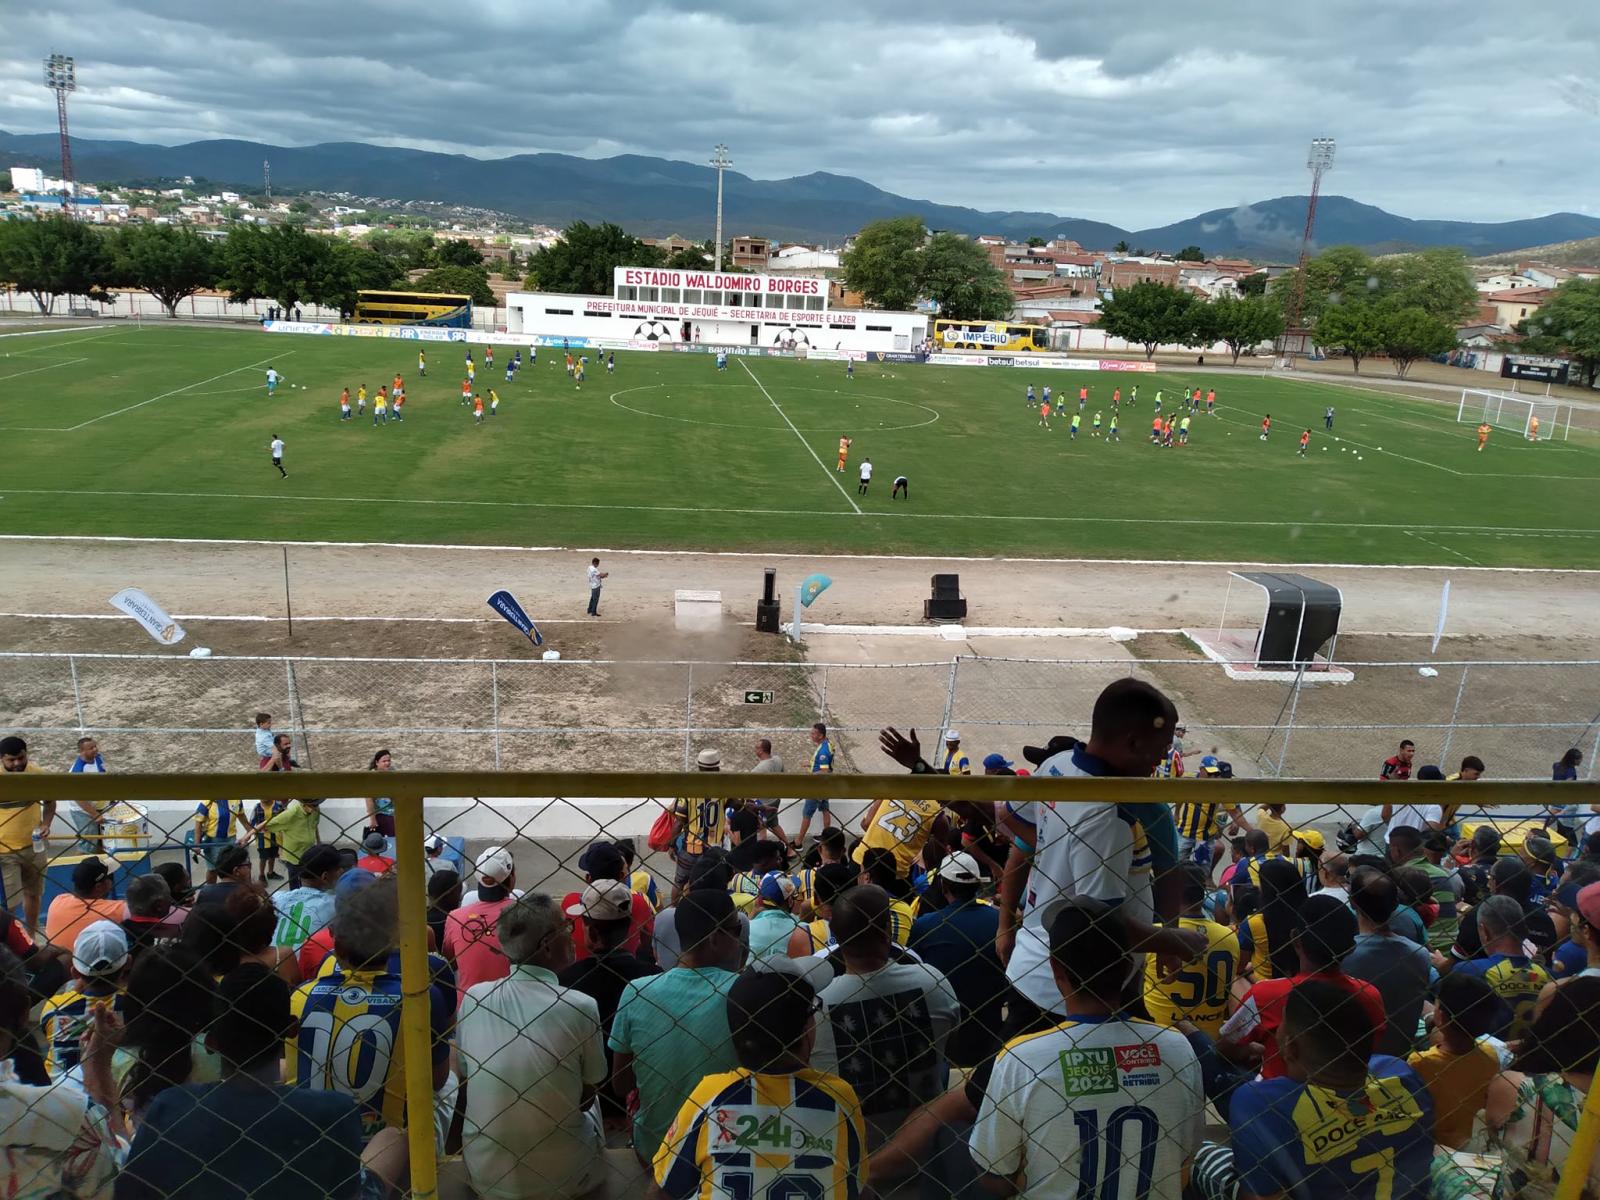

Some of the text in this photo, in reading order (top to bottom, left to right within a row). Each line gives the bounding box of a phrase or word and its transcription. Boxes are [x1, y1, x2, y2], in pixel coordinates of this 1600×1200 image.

[625, 269, 819, 294] ESTÁDIO WALDOMIRO BORGES
[586, 301, 635, 313] PREFEITURA
[637, 304, 676, 315] MUNICIPAL
[679, 306, 689, 315] DE
[691, 306, 718, 317] JEQUIÉ
[730, 309, 777, 320] SECRETARIA
[780, 311, 789, 321] DE
[791, 313, 824, 323] ESPORTE
[826, 314, 832, 323] E
[833, 315, 857, 324] LAZER
[989, 358, 1014, 367] betsul
[1015, 359, 1040, 367] betsul
[697, 801, 719, 828] 10
[878, 799, 921, 843] 23
[302, 1011, 393, 1103] 10
[1065, 1051, 1109, 1066] IPTU
[1069, 1076, 1115, 1092] 2022
[1313, 1118, 1367, 1152] DOCE
[1074, 1105, 1159, 1200] 10
[1350, 1146, 1395, 1200] 7
